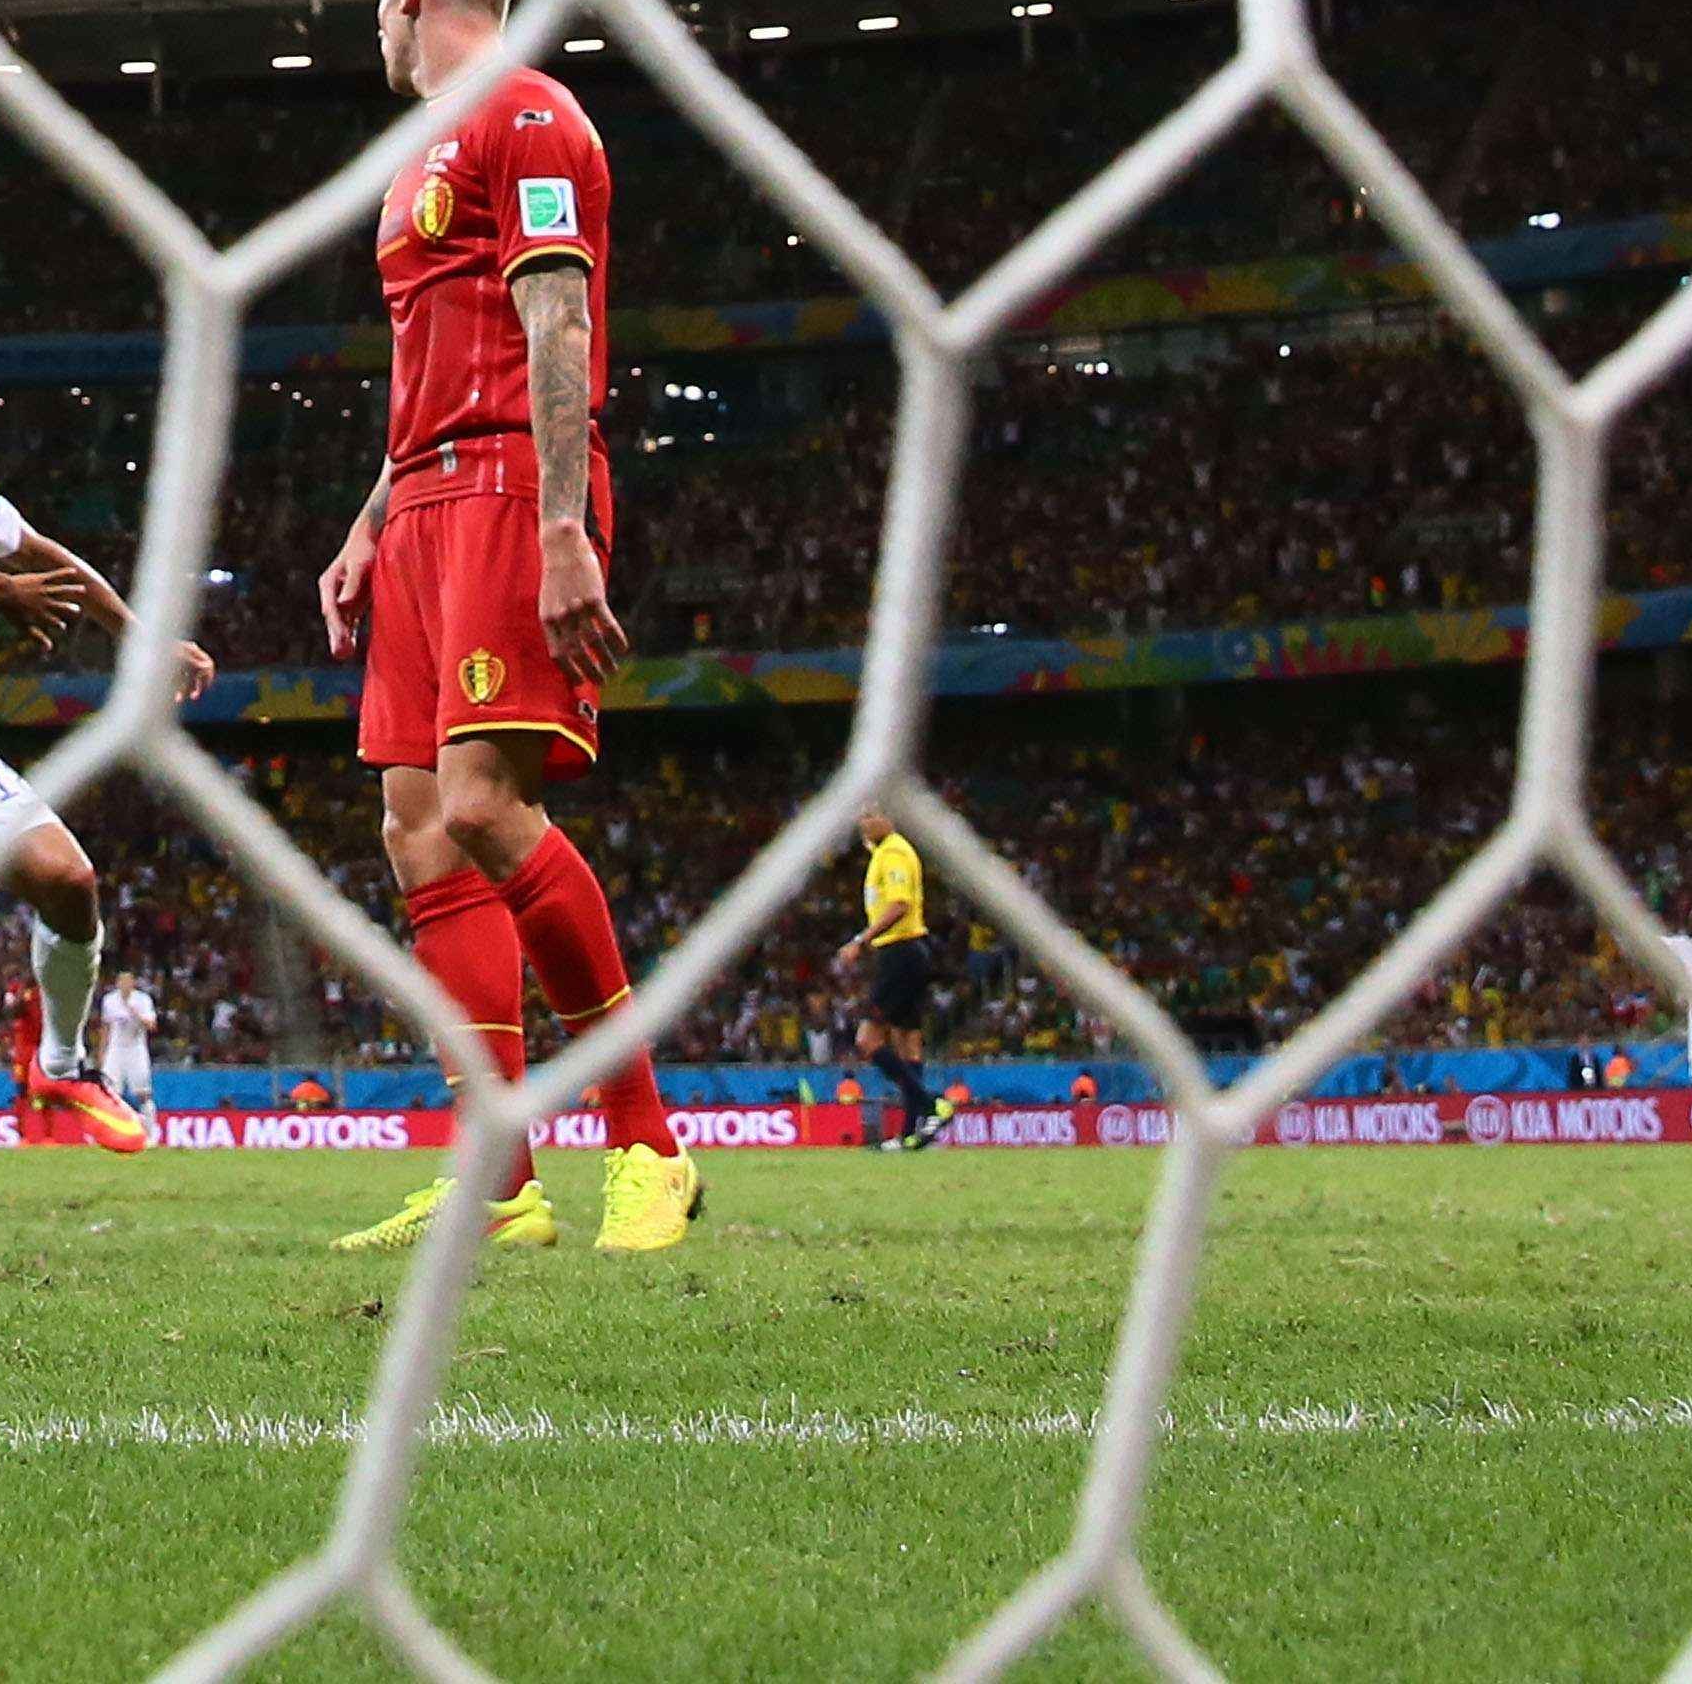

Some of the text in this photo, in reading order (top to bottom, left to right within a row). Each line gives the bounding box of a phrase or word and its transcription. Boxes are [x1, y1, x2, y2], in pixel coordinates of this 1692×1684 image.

[166, 1114, 409, 1150] KIA MOTORS
[666, 1109, 798, 1145] OTORS
[990, 1111, 1077, 1145] MOTORS
[1314, 1104, 1349, 1143] KIA
[1353, 1101, 1444, 1143] MOTORS
[1510, 1098, 1554, 1142] KIA
[1556, 1096, 1663, 1142] MOTORS
